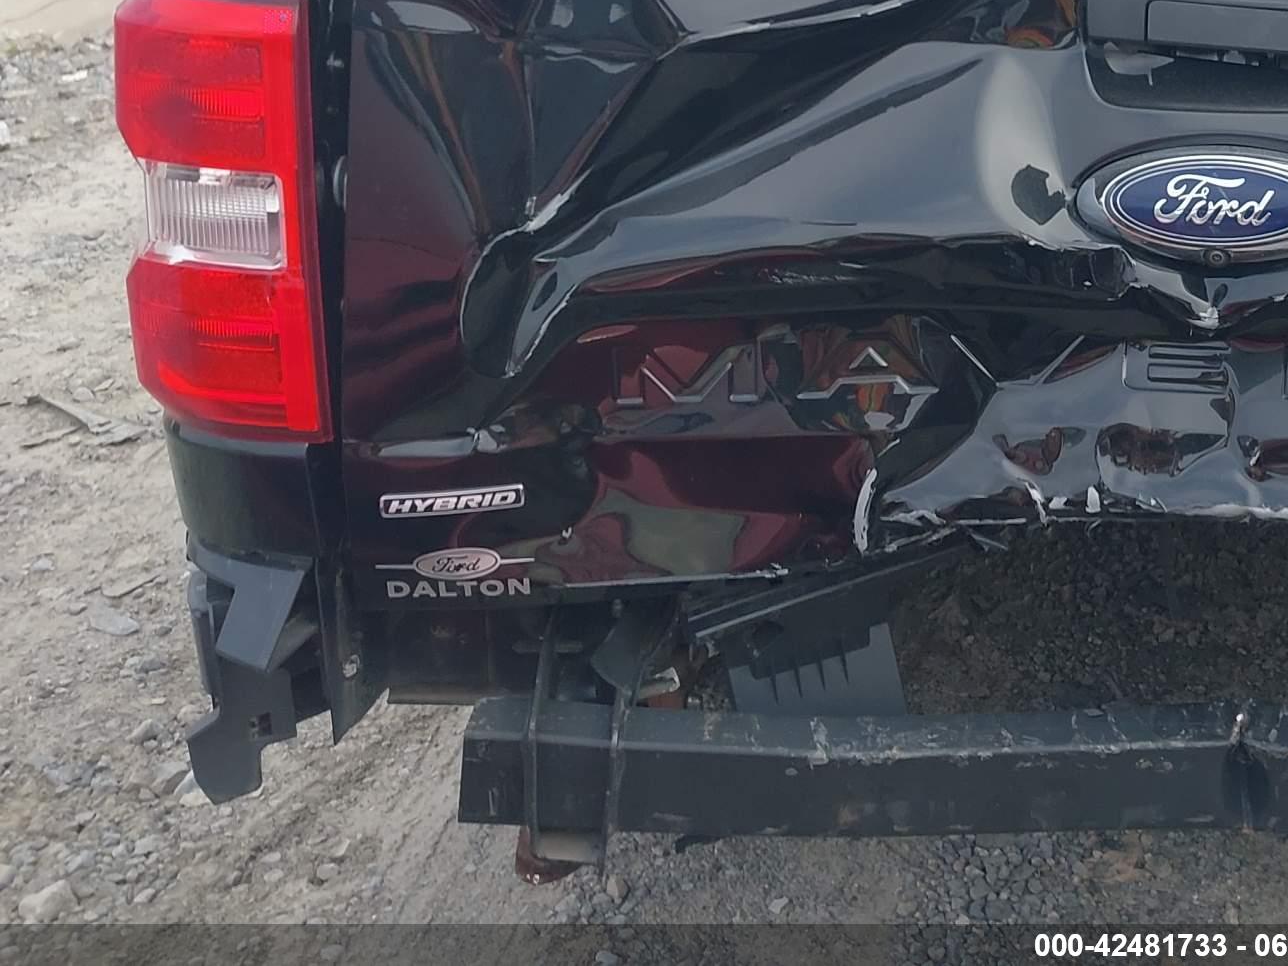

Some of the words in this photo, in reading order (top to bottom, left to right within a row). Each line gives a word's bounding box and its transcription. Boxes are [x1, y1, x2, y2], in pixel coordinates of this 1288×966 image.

[1153, 173, 1276, 227] Ford
[388, 490, 517, 514] HYBRID
[432, 554, 481, 573] Ford
[386, 577, 531, 598] DALTON
